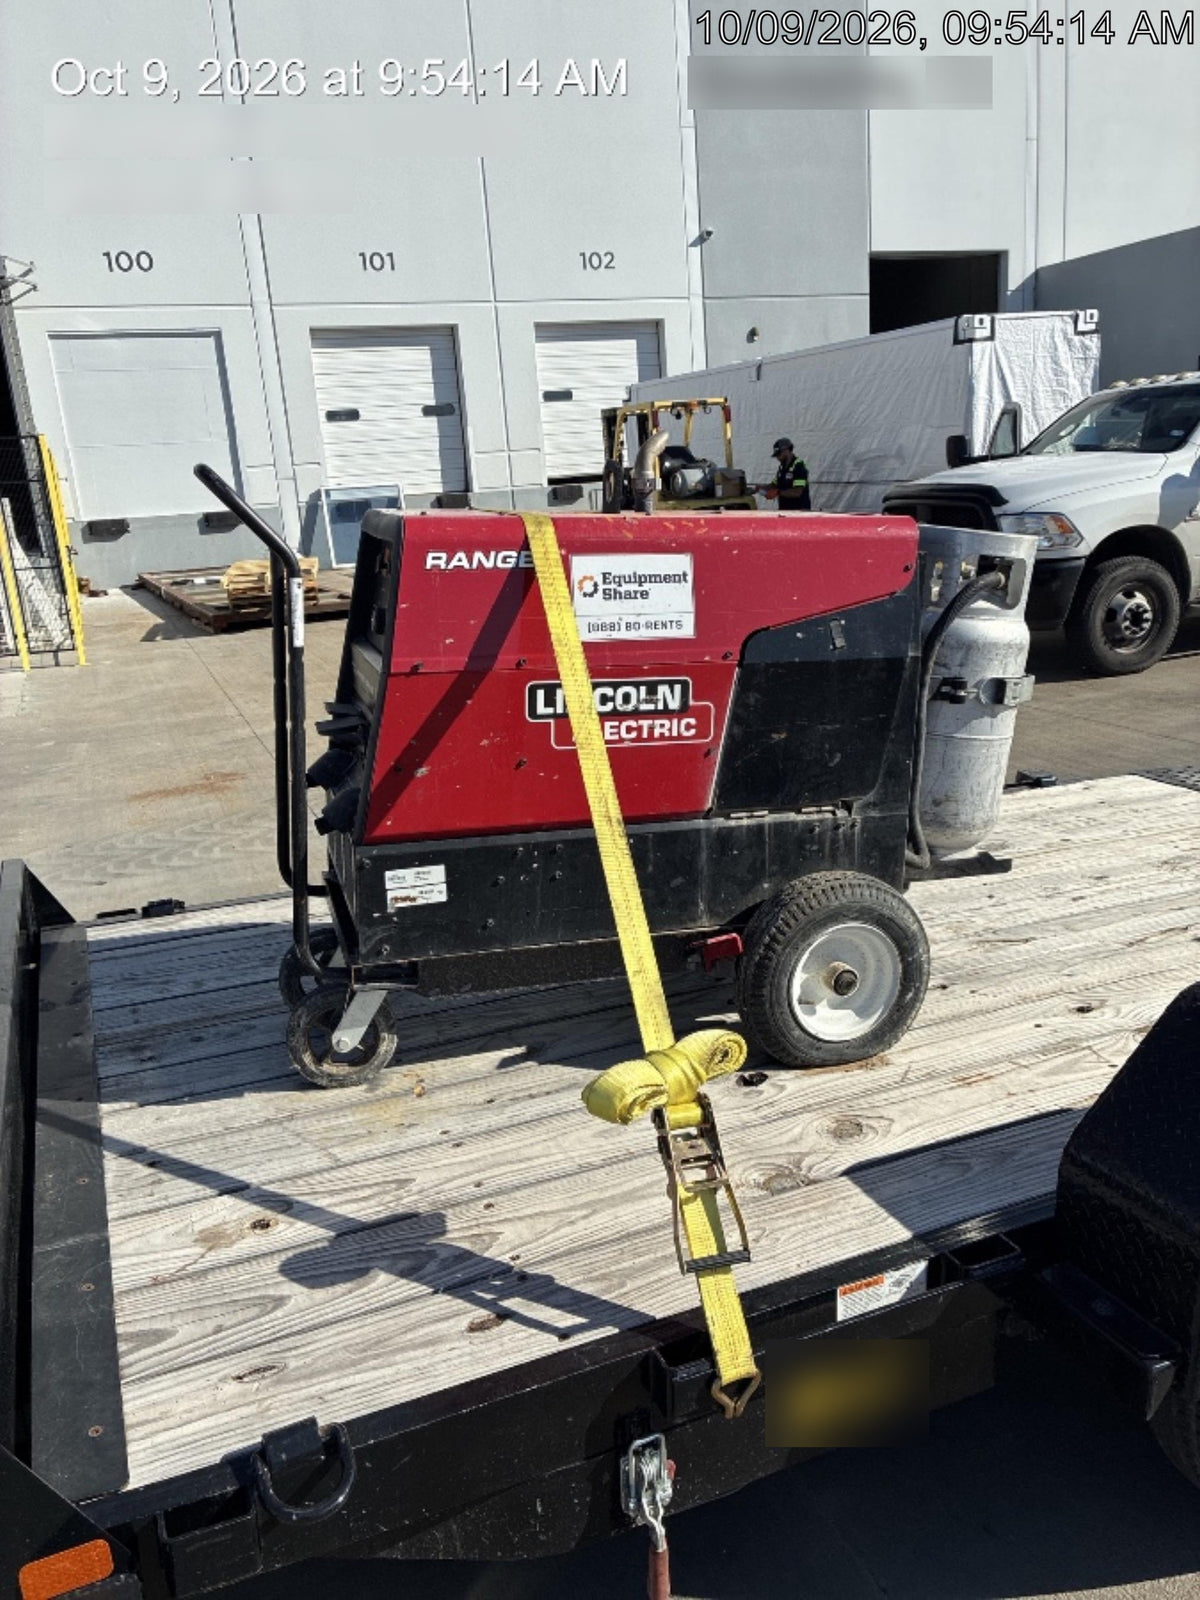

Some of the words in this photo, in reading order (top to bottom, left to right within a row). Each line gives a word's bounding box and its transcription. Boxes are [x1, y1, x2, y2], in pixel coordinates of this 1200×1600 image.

[102, 250, 154, 273] 100
[358, 251, 396, 272] 101
[579, 251, 616, 271] 102
[424, 550, 535, 570] RANGE
[601, 570, 689, 587] Equipment
[602, 588, 650, 601] Share
[535, 684, 682, 716] LICOLN
[572, 717, 697, 743] ECTRIC
